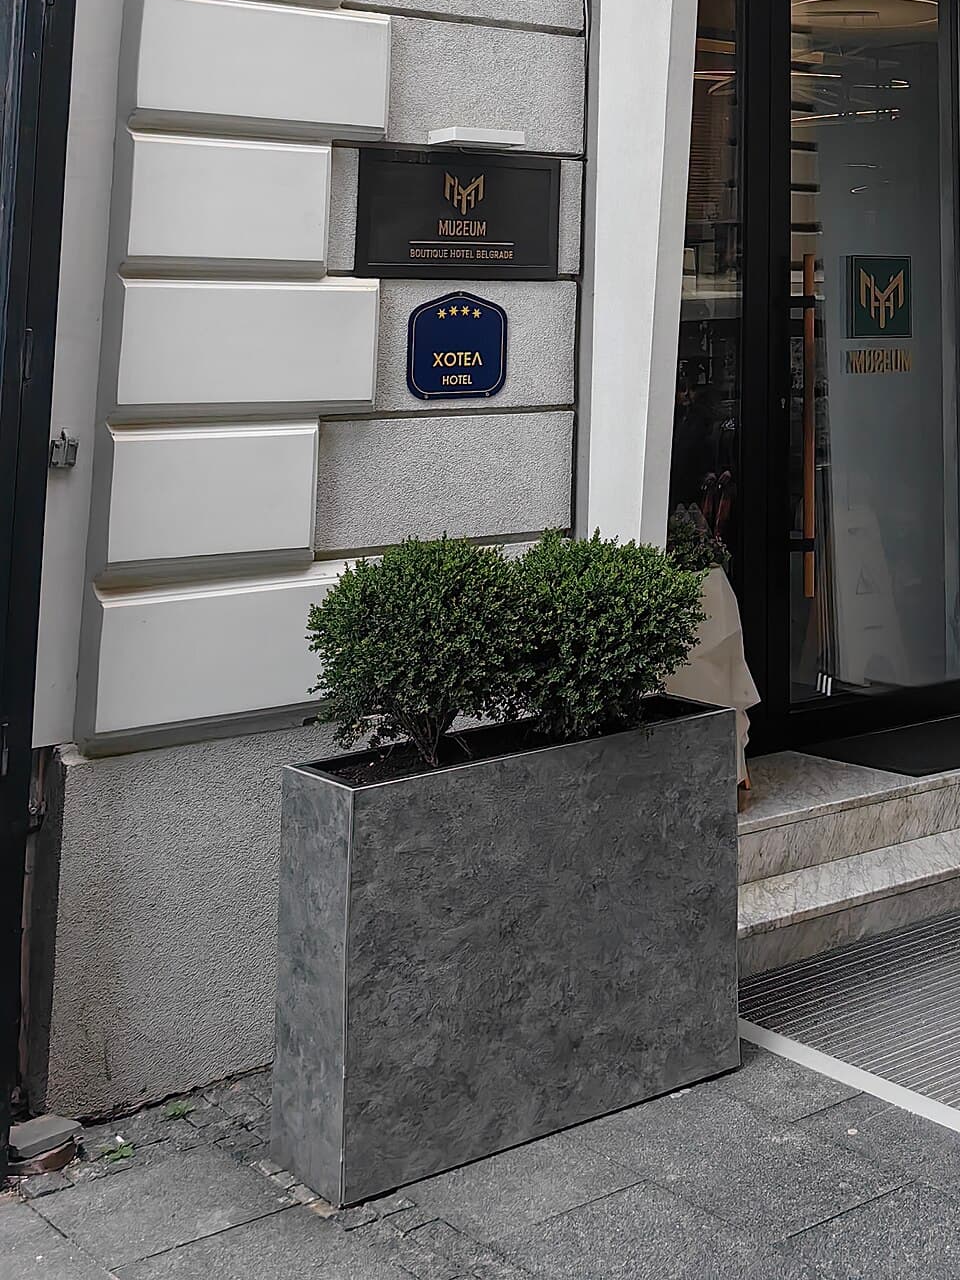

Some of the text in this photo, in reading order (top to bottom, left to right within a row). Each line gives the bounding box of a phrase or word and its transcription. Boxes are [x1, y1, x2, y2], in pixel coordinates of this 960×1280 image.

[438, 220, 487, 237] MUSEUM
[409, 248, 513, 260] BOUTIQUE HOTEL BELGRADE
[849, 348, 912, 374] MUSEUM
[442, 374, 473, 386] HOTEL
